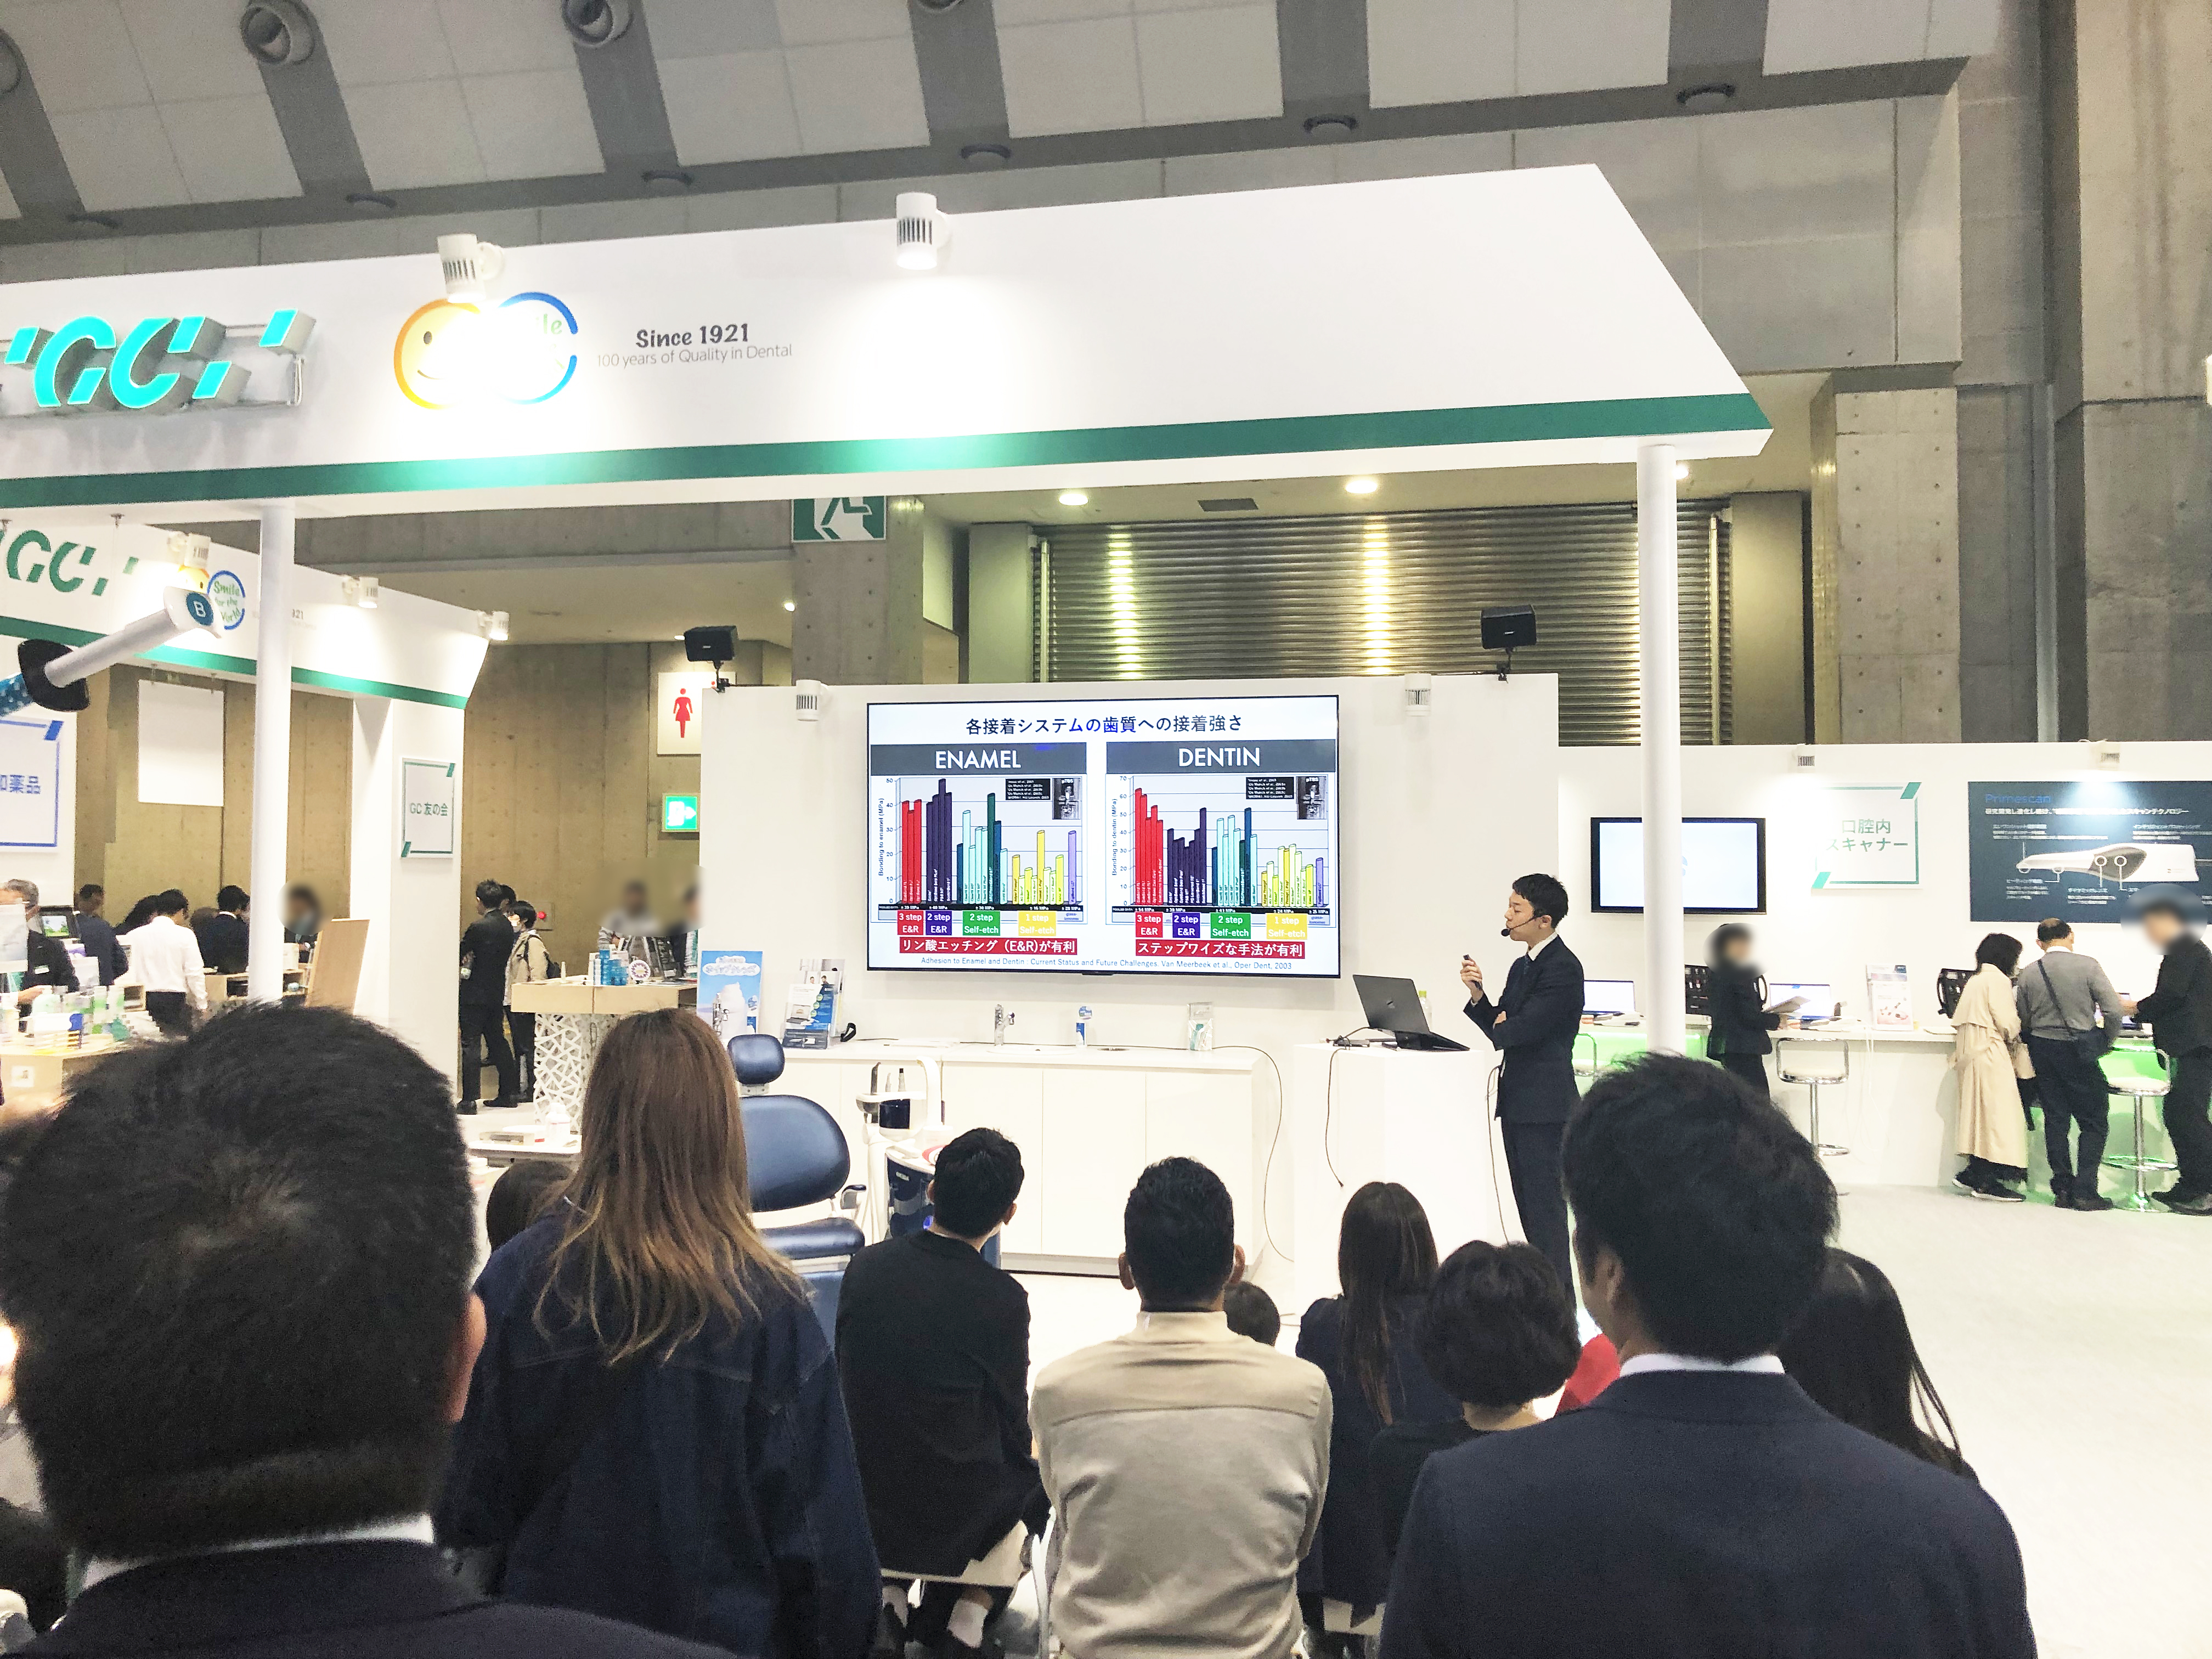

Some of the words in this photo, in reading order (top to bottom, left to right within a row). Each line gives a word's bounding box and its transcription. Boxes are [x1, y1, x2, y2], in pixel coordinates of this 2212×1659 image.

[636, 329, 692, 348] Since
[699, 323, 749, 344] 1921
[598, 354, 619, 367] 100
[623, 353, 657, 369] years
[661, 350, 675, 363] of
[679, 348, 727, 363] Quality
[731, 347, 743, 358] in
[747, 343, 792, 358] Dental
[213, 580, 240, 595] Smile
[966, 715, 1242, 735] 各接着システムの歯質への接着強さ
[935, 749, 1021, 769] ENAMEL
[1178, 747, 1260, 767] DENTIN
[1842, 819, 1891, 833] 口腔内
[1826, 838, 1908, 852] スキャナー
[906, 913, 922, 922] step
[977, 914, 993, 922] step
[1144, 915, 1161, 924] step
[1181, 916, 1198, 924] step
[1225, 916, 1243, 925] step
[1282, 917, 1299, 926] step
[1212, 928, 1249, 936] Self-etch
[1268, 929, 1305, 938] Self-etch
[1138, 942, 1302, 957] ステップワイズな手法が有利
